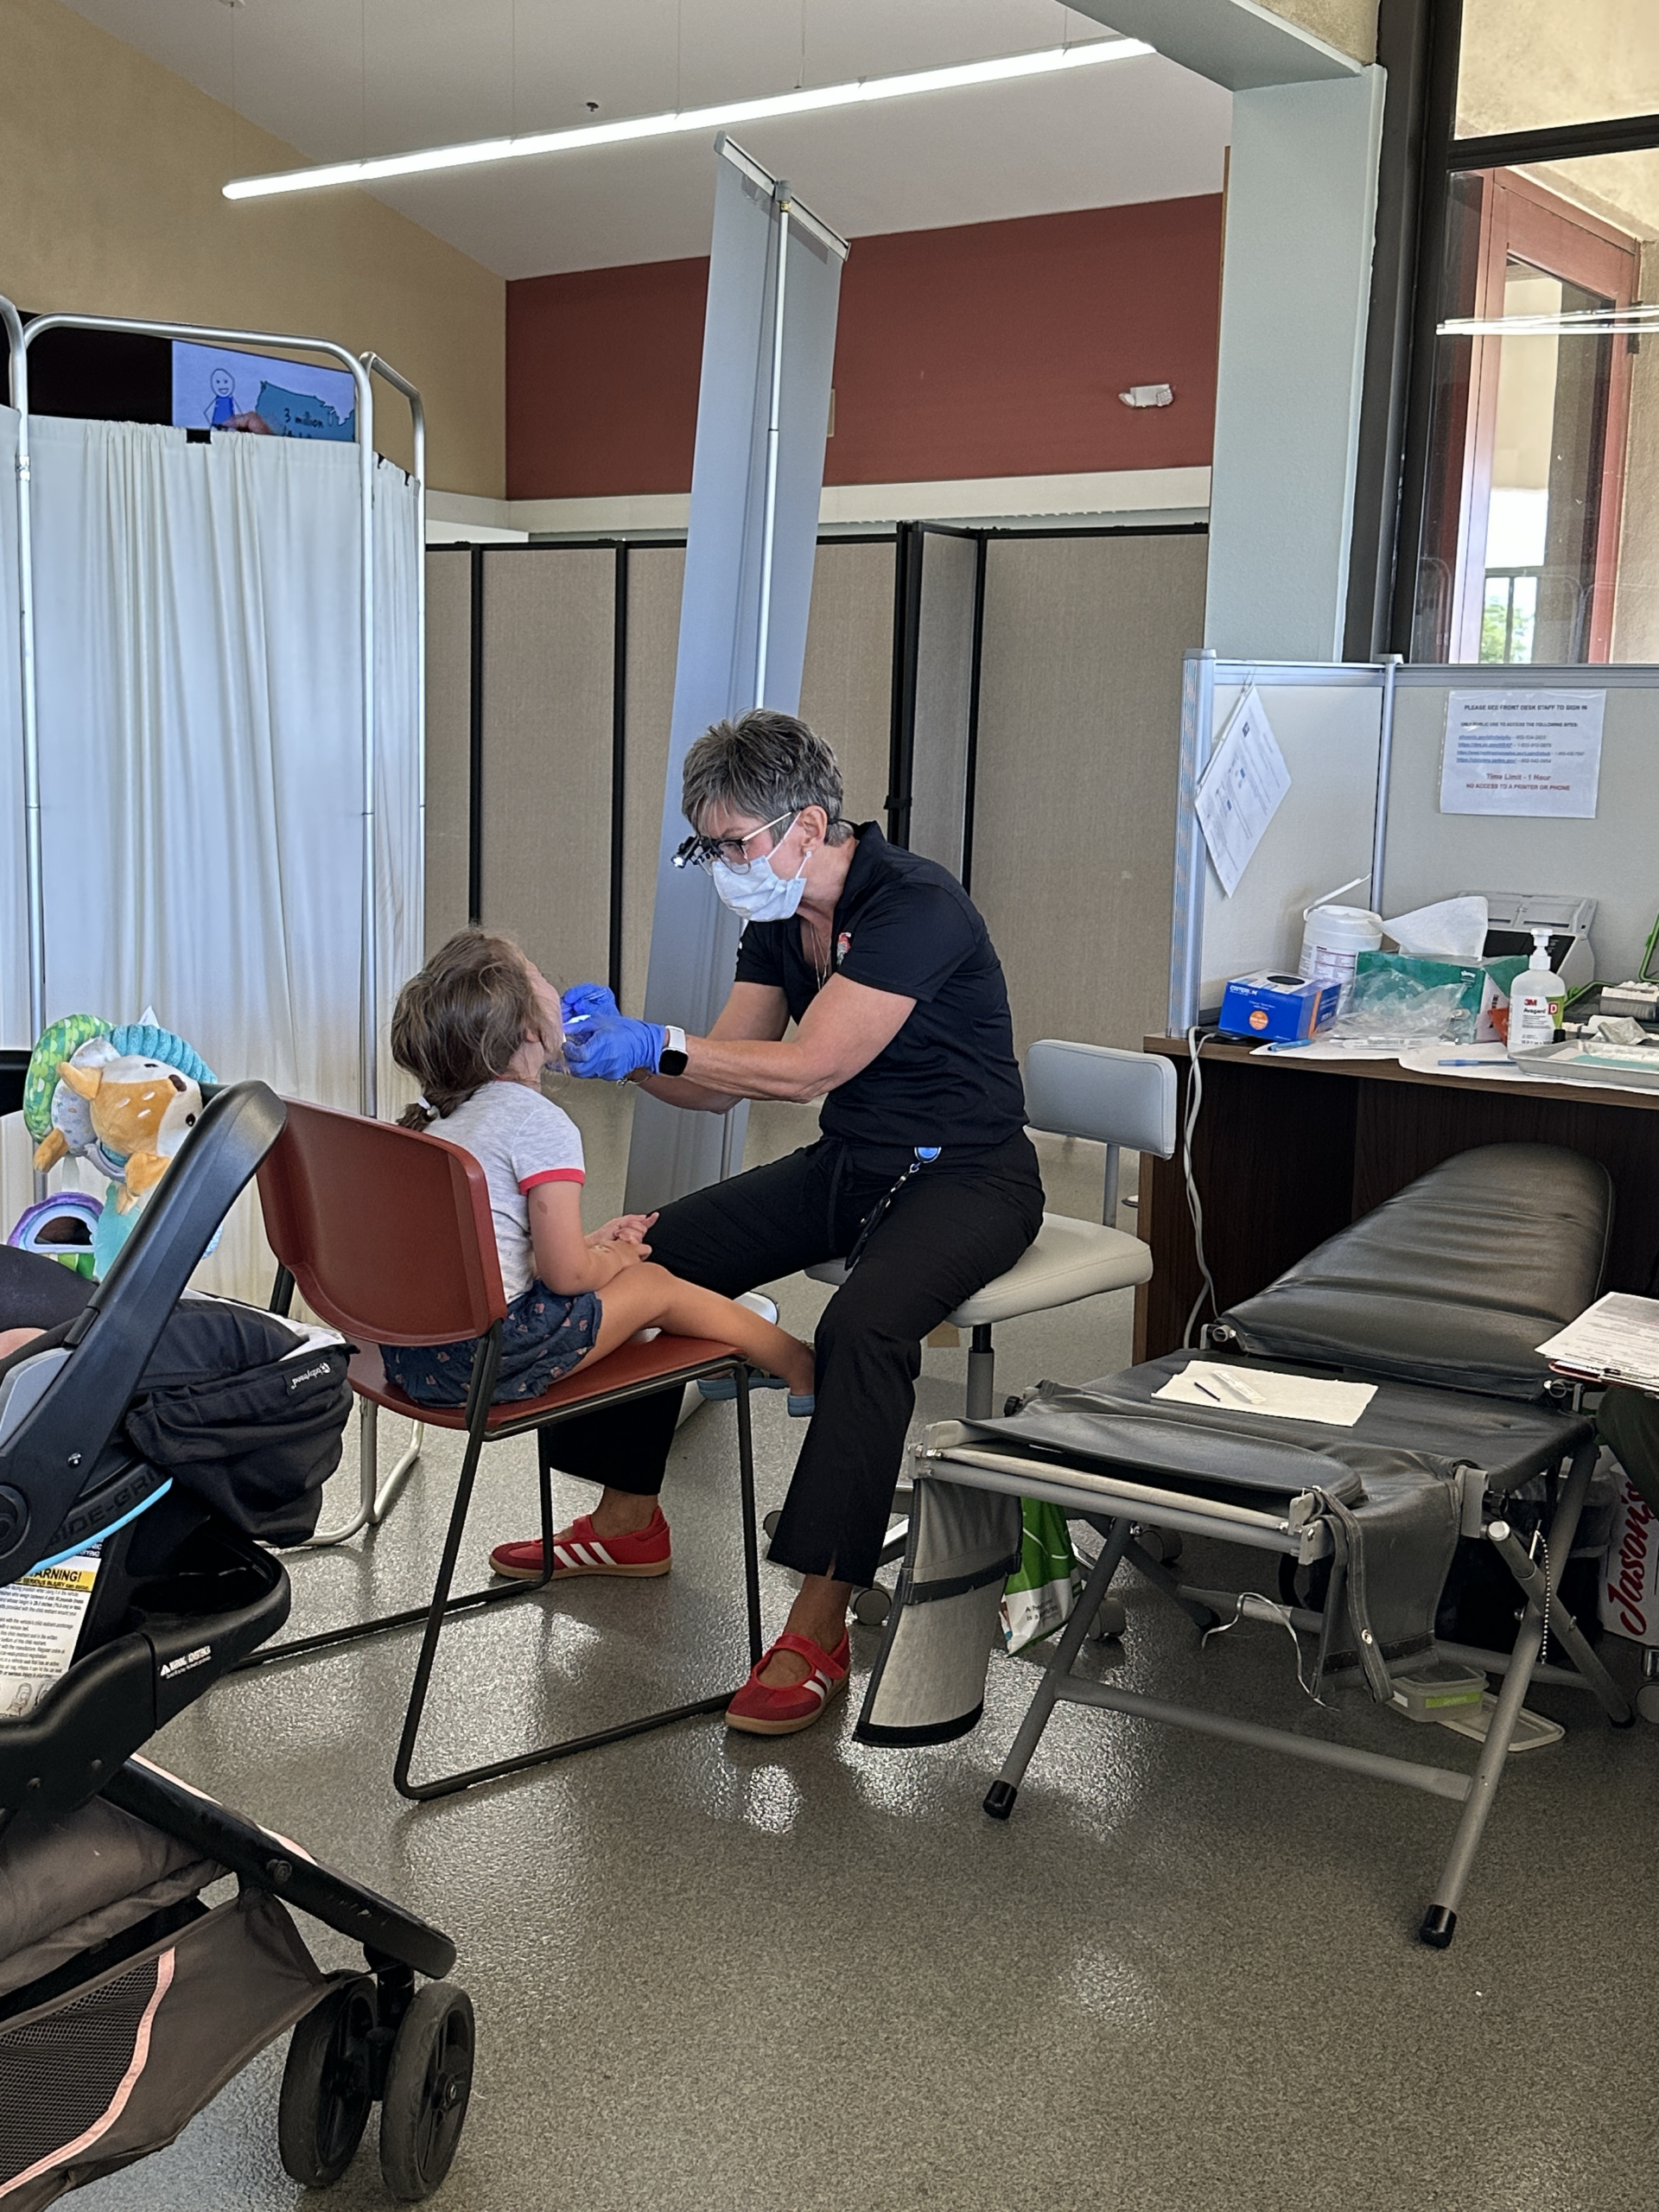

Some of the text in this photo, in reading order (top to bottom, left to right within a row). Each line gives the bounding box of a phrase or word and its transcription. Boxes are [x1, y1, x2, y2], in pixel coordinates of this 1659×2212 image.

[284, 407, 291, 423] 3
[1549, 1003, 1558, 1014] D
[30, 1568, 82, 1583] ARNING!
